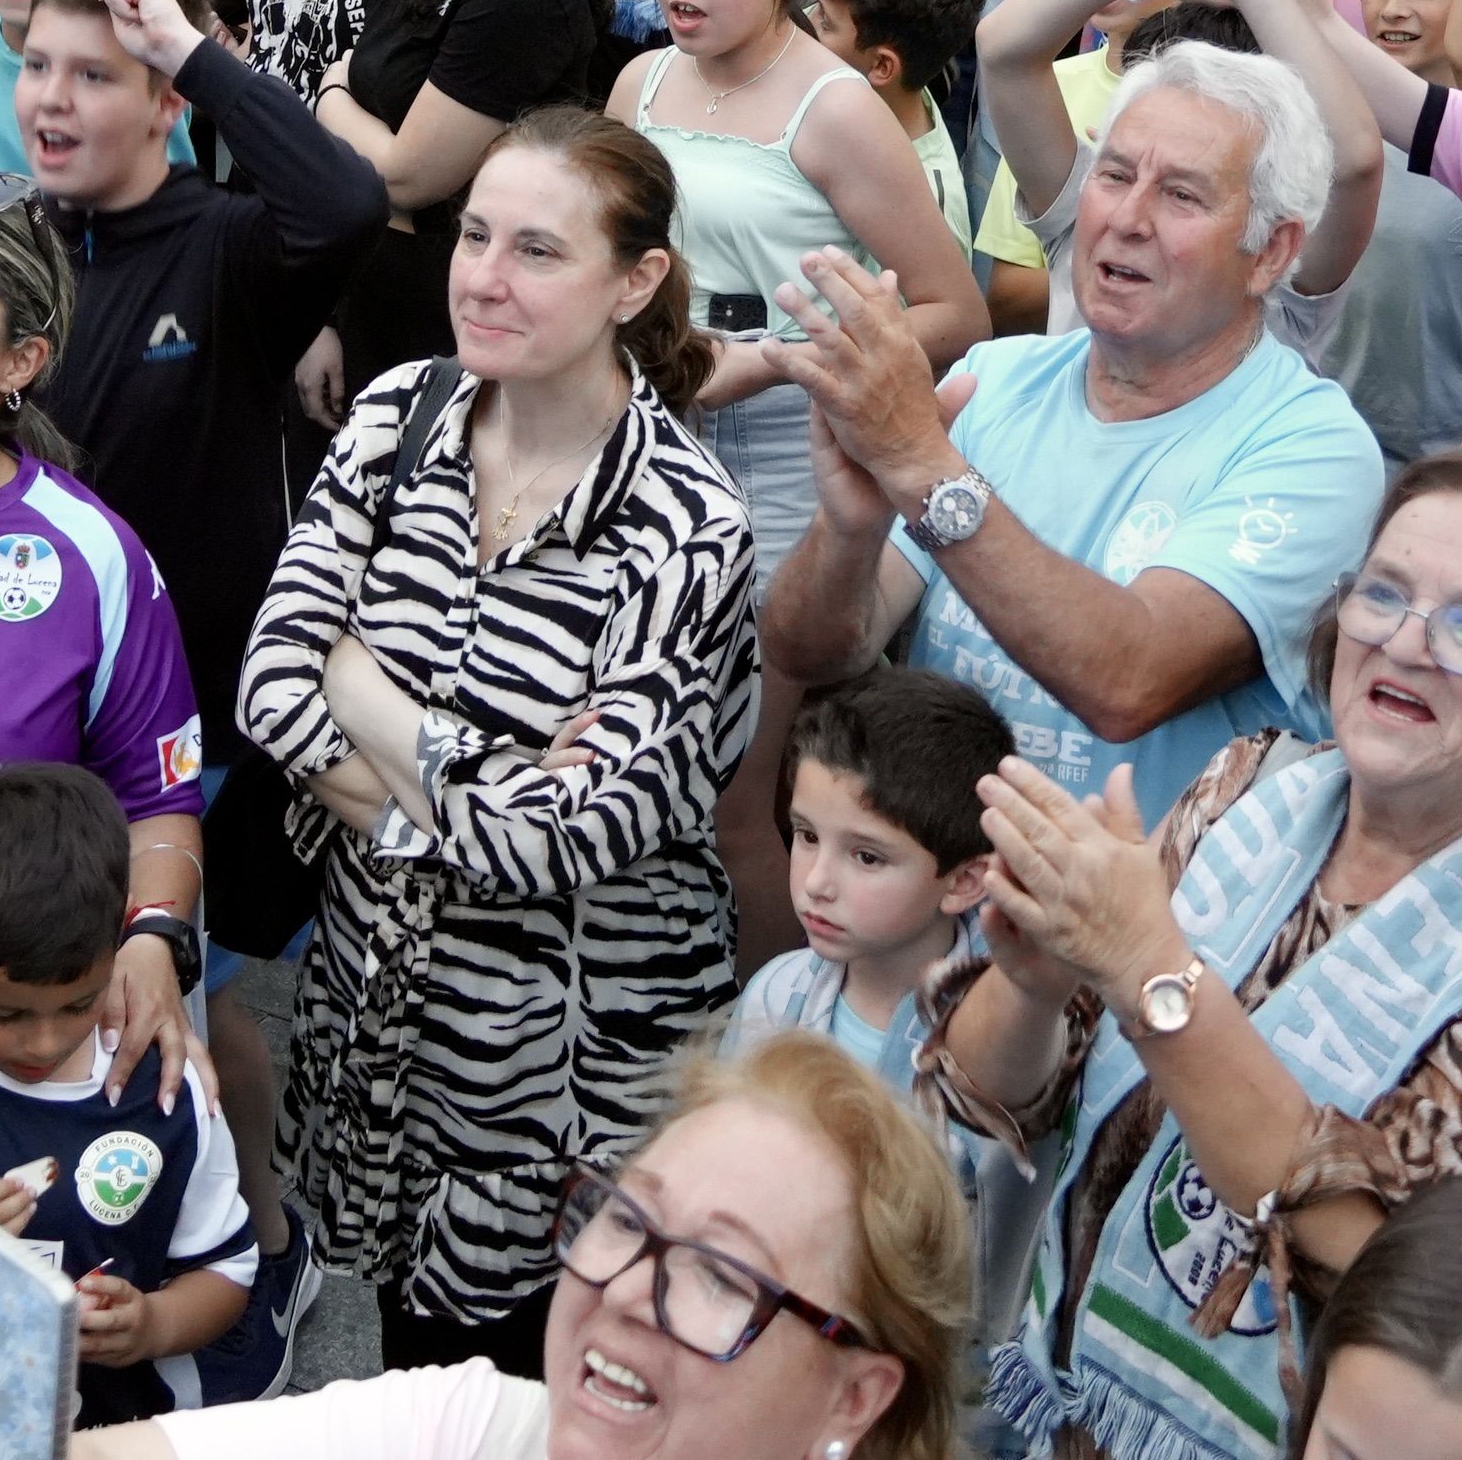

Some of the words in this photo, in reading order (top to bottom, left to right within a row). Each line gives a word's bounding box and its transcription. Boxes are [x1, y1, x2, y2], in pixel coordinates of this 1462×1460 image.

[12, 571, 24, 584] de
[27, 572, 59, 588] Lucena
[94, 1135, 155, 1159] FUNDACIÓN
[88, 1198, 122, 1221] LUCENA
